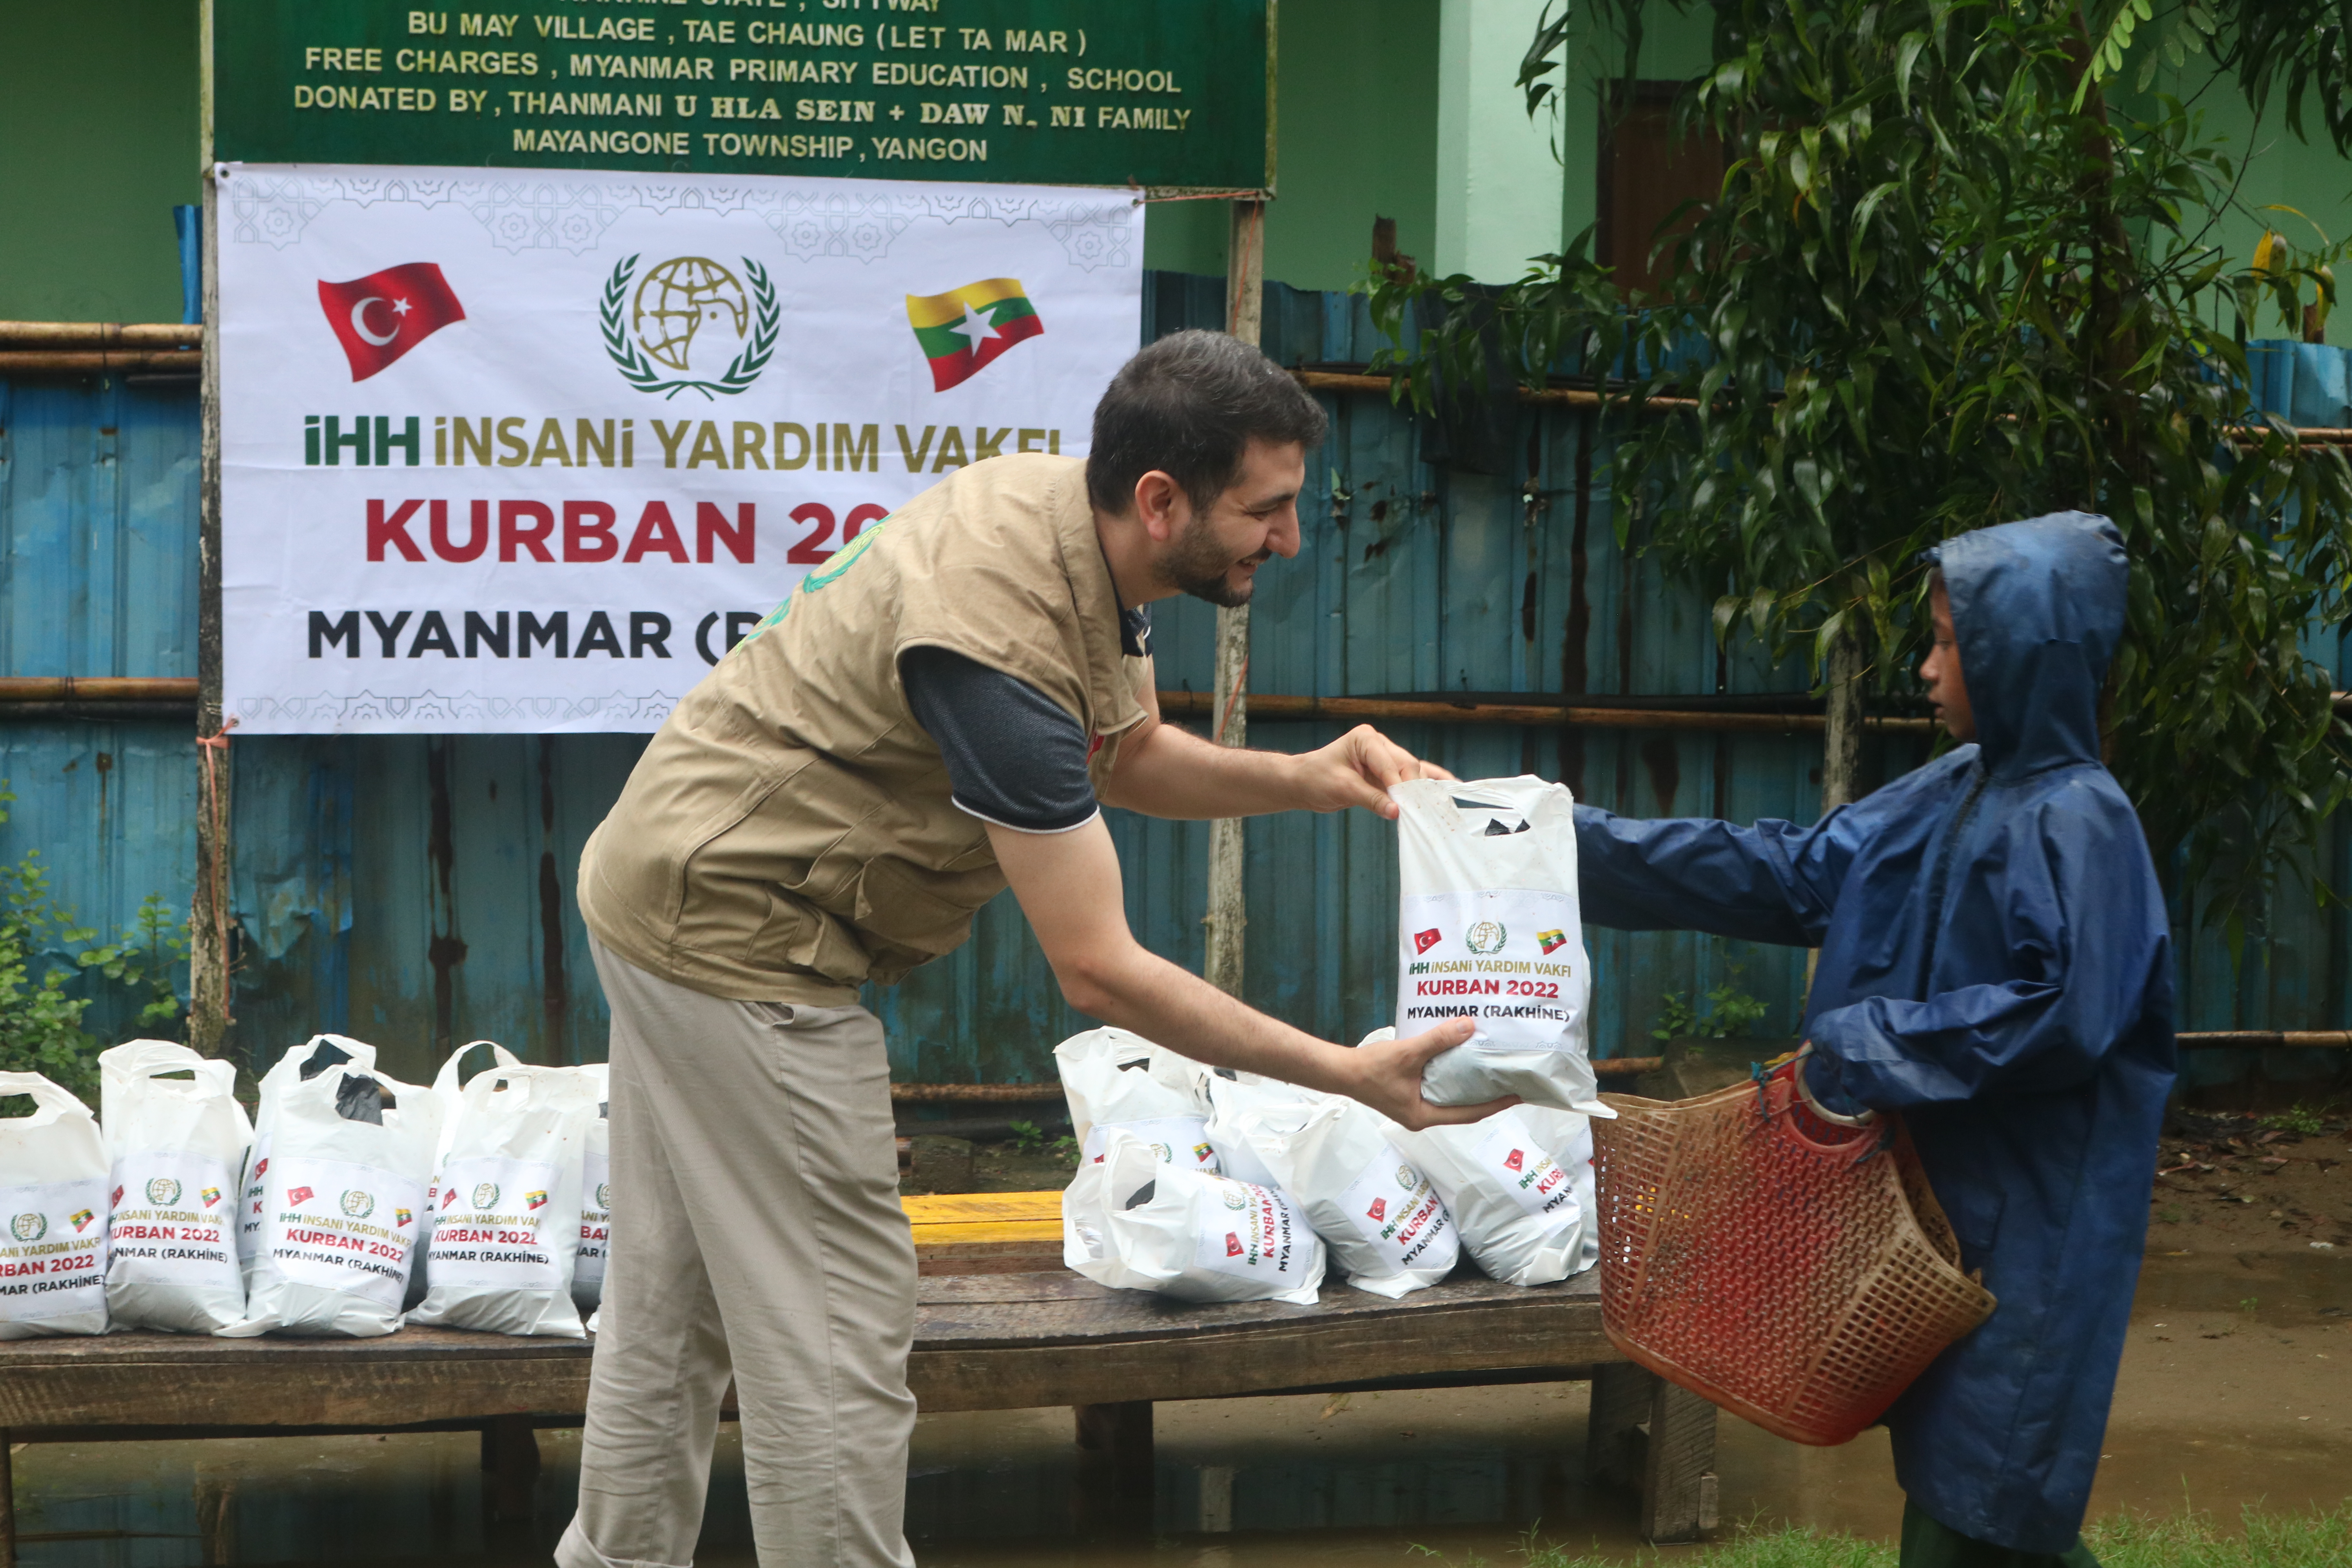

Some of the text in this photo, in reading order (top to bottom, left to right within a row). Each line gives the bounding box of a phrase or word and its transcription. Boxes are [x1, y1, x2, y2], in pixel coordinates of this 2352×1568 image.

[408, 11, 447, 34] BU
[460, 13, 519, 37] MAY
[534, 15, 655, 41] VILLAGE
[682, 20, 736, 44] TAE
[748, 21, 864, 47] CHAUNG
[958, 28, 992, 50] TA
[305, 47, 382, 71] FREE
[396, 49, 539, 75] CHARGES
[570, 54, 714, 80] MYANMAR
[730, 59, 858, 83] PRIMARY
[872, 62, 1028, 89] EDUCATION
[1067, 67, 1181, 93] SCHOOL
[294, 85, 436, 111] DONATED
[508, 91, 662, 116] THANMANI
[675, 95, 697, 117] U
[711, 97, 782, 120] HLA
[795, 99, 875, 122] SEIN
[920, 103, 990, 125] DAW
[1050, 106, 1085, 127] NI
[1098, 107, 1191, 130] FAMILY
[513, 129, 690, 155] MAYANGONE
[871, 137, 987, 162] YANGON
[651, 420, 878, 472] YARDIM
[367, 499, 755, 564] KURBAN
[309, 610, 672, 659] MYANMAR
[1475, 960, 1531, 974] YARDIM
[1534, 962, 1571, 977] VAKFI
[1417, 979, 1559, 999] KURBAN 2022
[1408, 1005, 1479, 1019] MYANMAR
[154, 1210, 199, 1223] YARDIM
[346, 1221, 390, 1238] YARDIM
[475, 1215, 517, 1225] YARDIM
[1262, 1199, 1275, 1258] KURBAN
[1397, 1196, 1438, 1246] KURBAN
[22, 1242, 69, 1256] YARDIM
[181, 1227, 220, 1243] 2022
[286, 1228, 404, 1264] KURBAN 2022
[498, 1230, 538, 1245] 2022
[1279, 1212, 1291, 1272] MYANMAR
[1401, 1219, 1445, 1265] MYANMAR
[51, 1254, 94, 1272] 2022
[273, 1248, 344, 1265] MYANMAR
